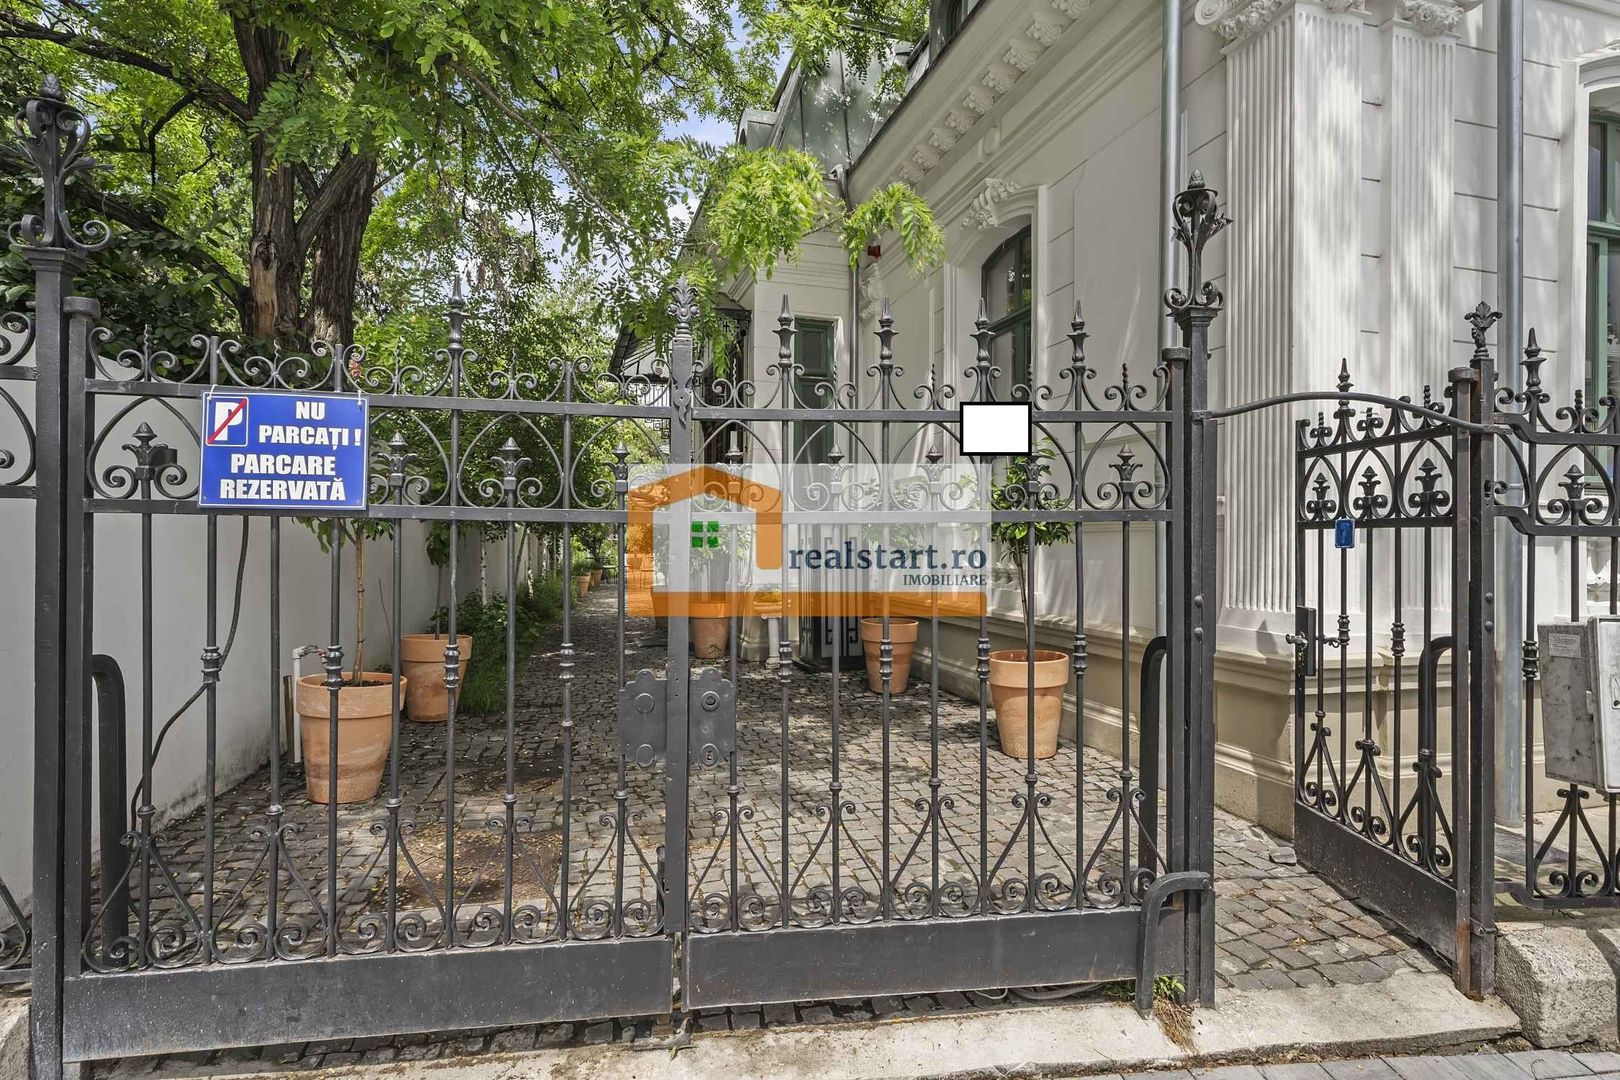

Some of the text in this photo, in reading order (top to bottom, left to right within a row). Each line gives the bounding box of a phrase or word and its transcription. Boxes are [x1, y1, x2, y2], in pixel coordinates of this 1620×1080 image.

[295, 401, 326, 420] NU
[230, 453, 336, 475] PARCARE
[220, 477, 346, 500] REZERVATĂ
